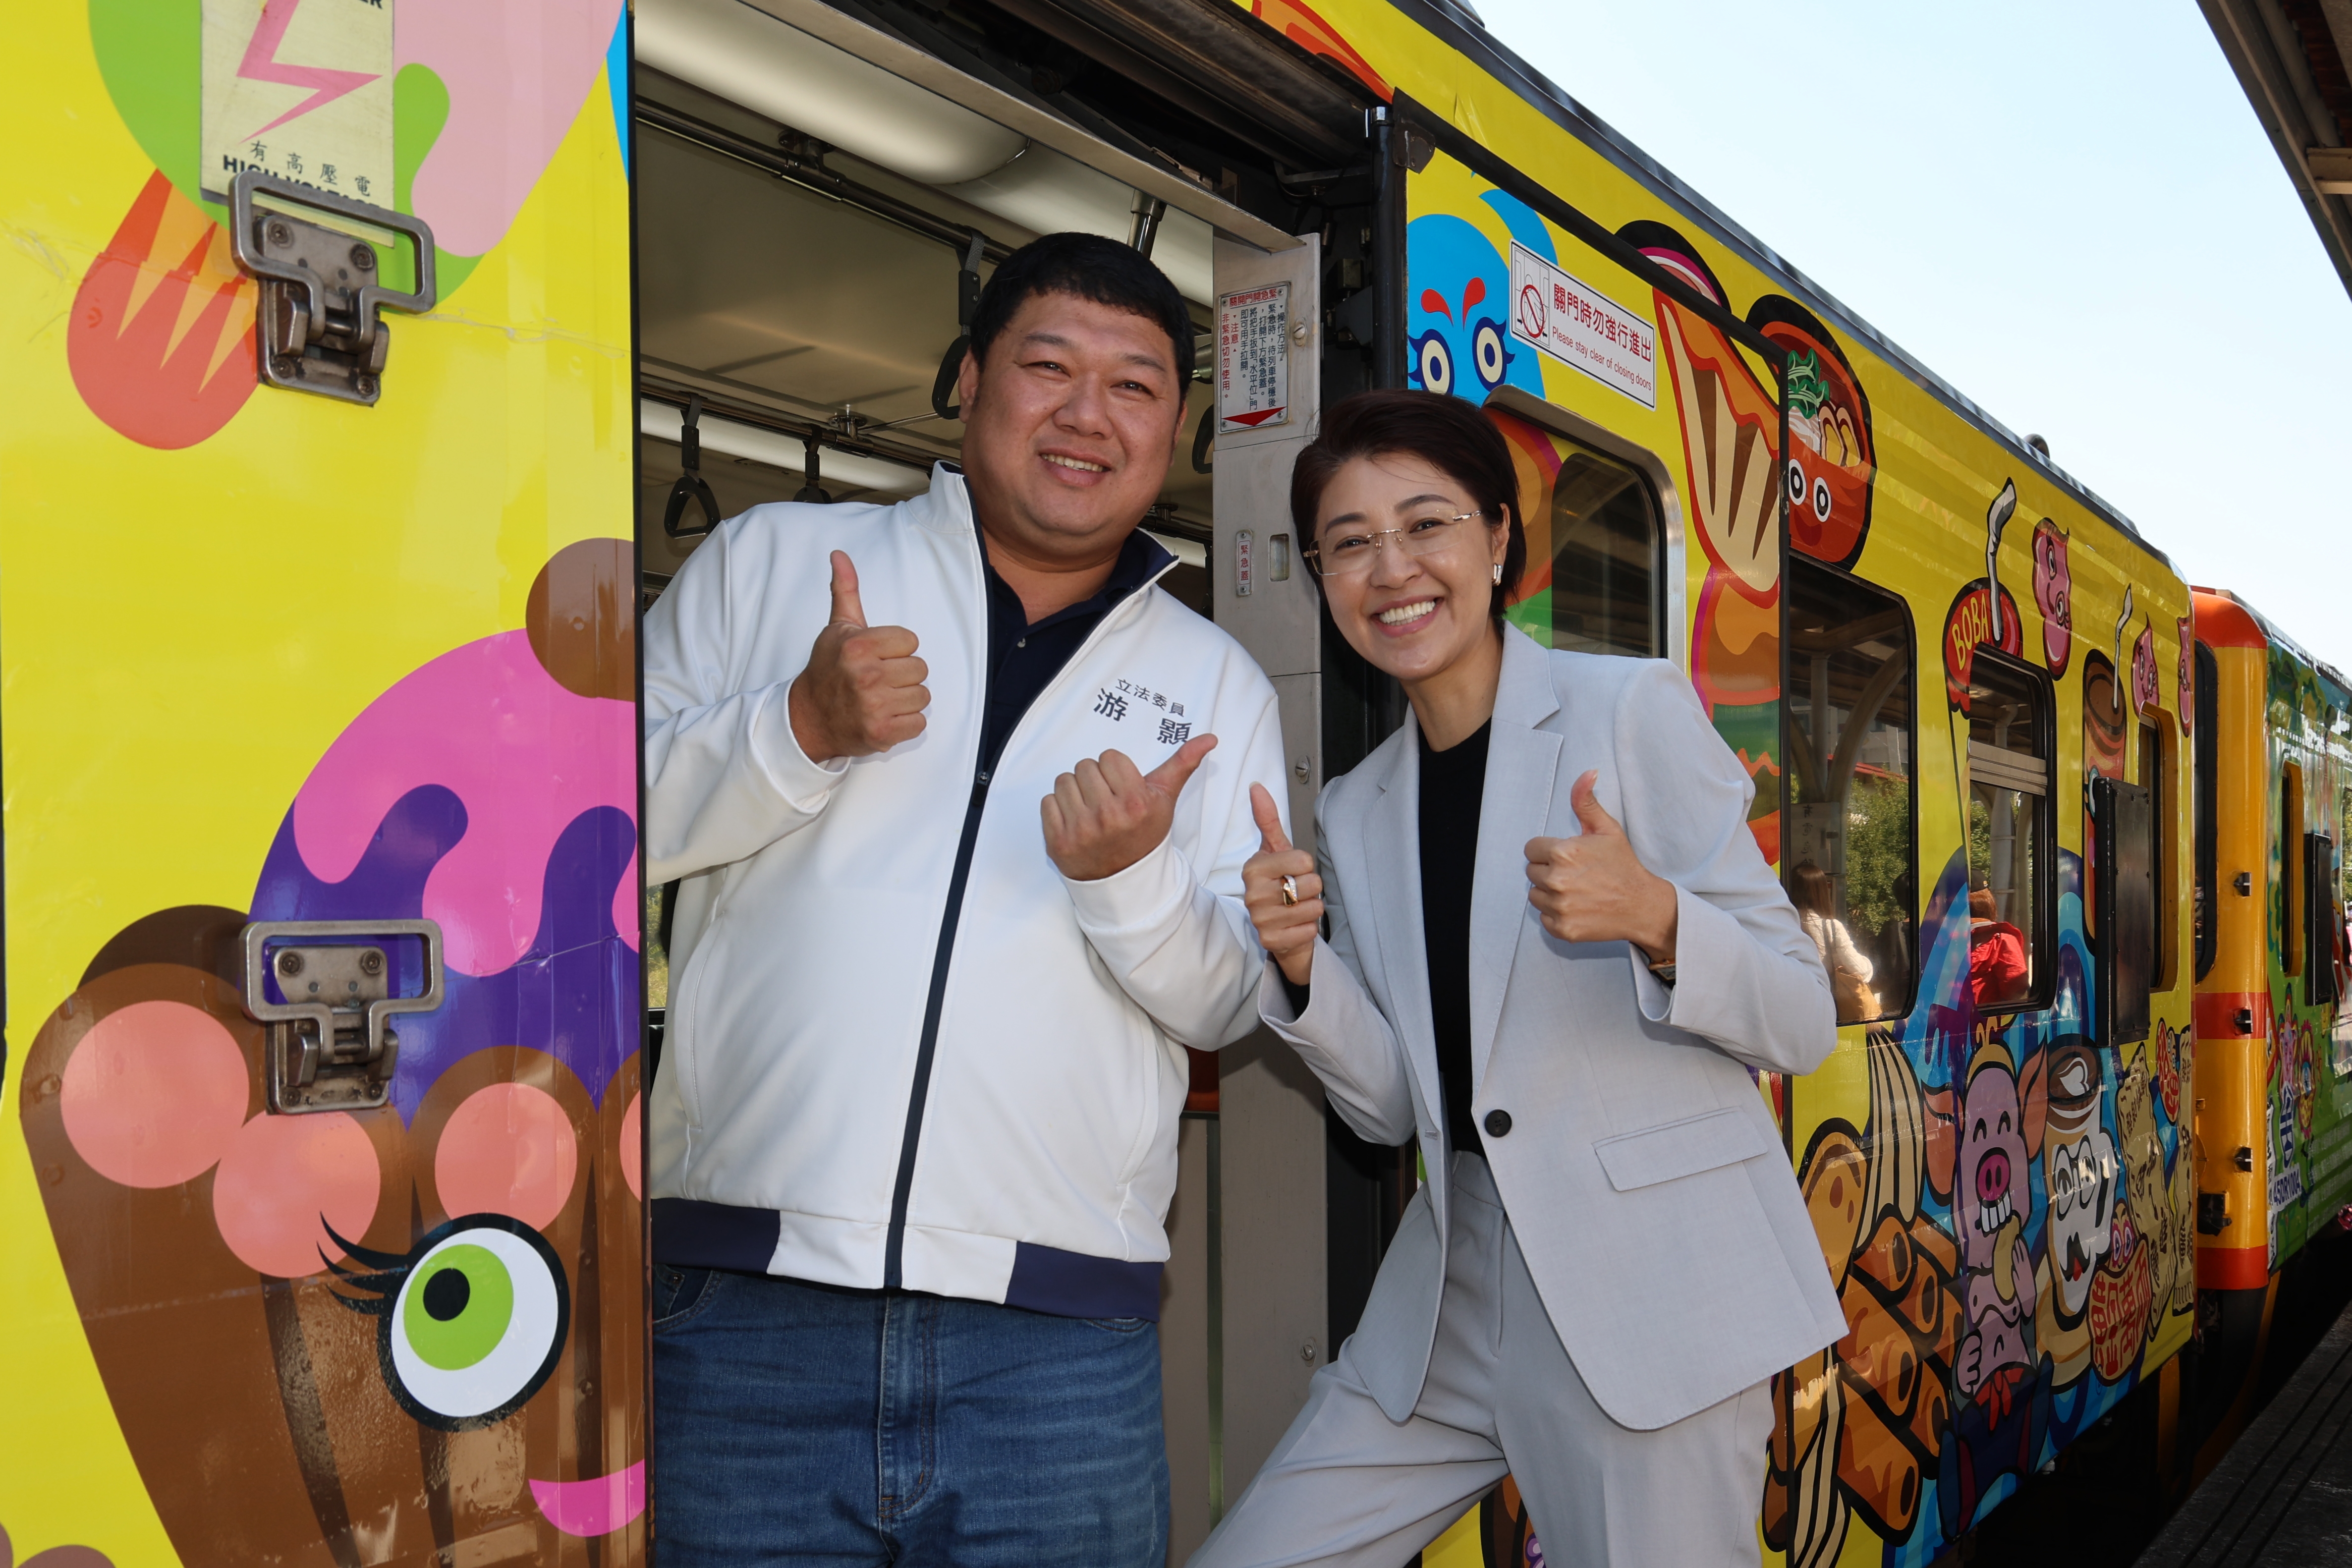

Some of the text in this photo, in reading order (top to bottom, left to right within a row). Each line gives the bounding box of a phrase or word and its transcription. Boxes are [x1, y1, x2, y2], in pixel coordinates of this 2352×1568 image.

[251, 140, 371, 197] 有高壓電
[1231, 322, 1239, 344] 注意
[1277, 312, 1286, 354] 操作方法
[1554, 283, 1651, 362] 關門時勿強行進出
[1552, 326, 1652, 391] Please stay clear of closing doors
[1240, 544, 1249, 581] 緊急蓋
[1952, 592, 1989, 670] BOBA
[1115, 679, 1185, 717] 立法委員
[2273, 1168, 2301, 1206] 45DR1004
